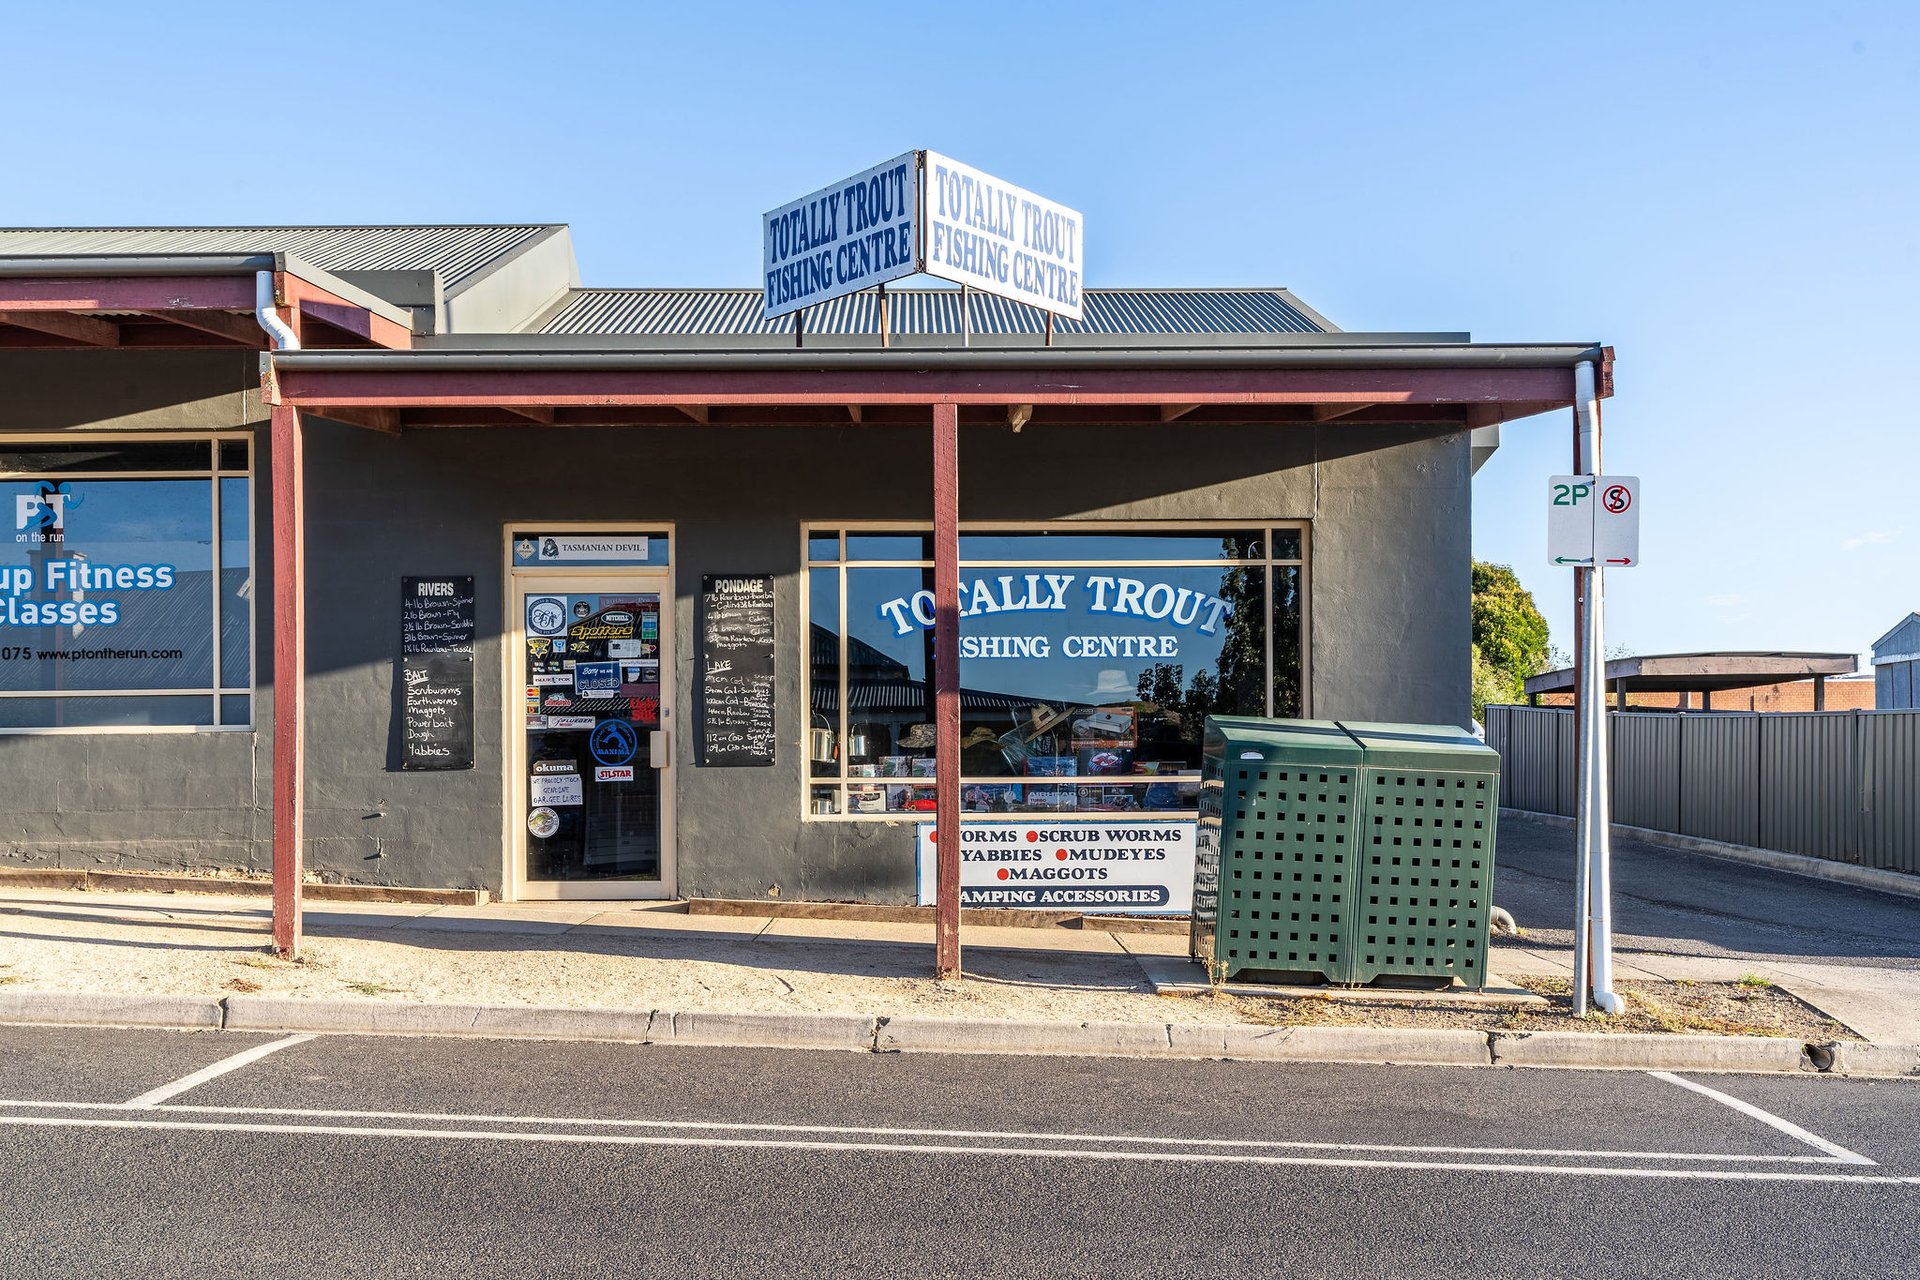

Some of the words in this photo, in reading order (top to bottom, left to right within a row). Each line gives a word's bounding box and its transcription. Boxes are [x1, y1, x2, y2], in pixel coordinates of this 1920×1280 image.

[770, 191, 840, 264] TOTALLY
[844, 164, 907, 235] TROUT
[936, 165, 1017, 238] TOTALLY
[1021, 201, 1076, 263] TROUT
[767, 249, 832, 308] FISHING
[836, 221, 910, 285] CENTRE
[933, 221, 1008, 283] FISHING
[1012, 245, 1078, 307] CENTRE
[1553, 484, 1589, 505] 2P
[16, 534, 28, 542] on
[31, 532, 46, 542] the
[49, 533, 64, 542] run
[562, 543, 613, 552] TASMANIAN
[47, 562, 173, 589] Fitness
[418, 582, 454, 596] RIVERS
[715, 579, 763, 593] PONDAGE
[1087, 576, 1234, 633] TROUT
[1062, 636, 1179, 658] CENTRE
[2, 647, 31, 660] 075
[37, 648, 183, 662] www.ptontherun.com
[707, 660, 731, 671] LAKE
[404, 669, 429, 682] BAIT
[408, 684, 462, 696] Scrubworms
[578, 678, 619, 689] CLOSED
[408, 696, 458, 706] Earthworms
[408, 729, 434, 741] Dough
[409, 743, 450, 756] Yabbies
[535, 764, 574, 772] okuma
[960, 830, 1017, 842] ORMS
[1039, 830, 1100, 842] SCRUB
[1108, 829, 1182, 842] WORMS
[961, 849, 1041, 861] YABBIES
[1070, 848, 1165, 860] MUDEYES
[1010, 867, 1108, 880] MAGGOTS
[960, 890, 1036, 903] AMPING
[1040, 890, 1160, 903] ACCESSORIES
